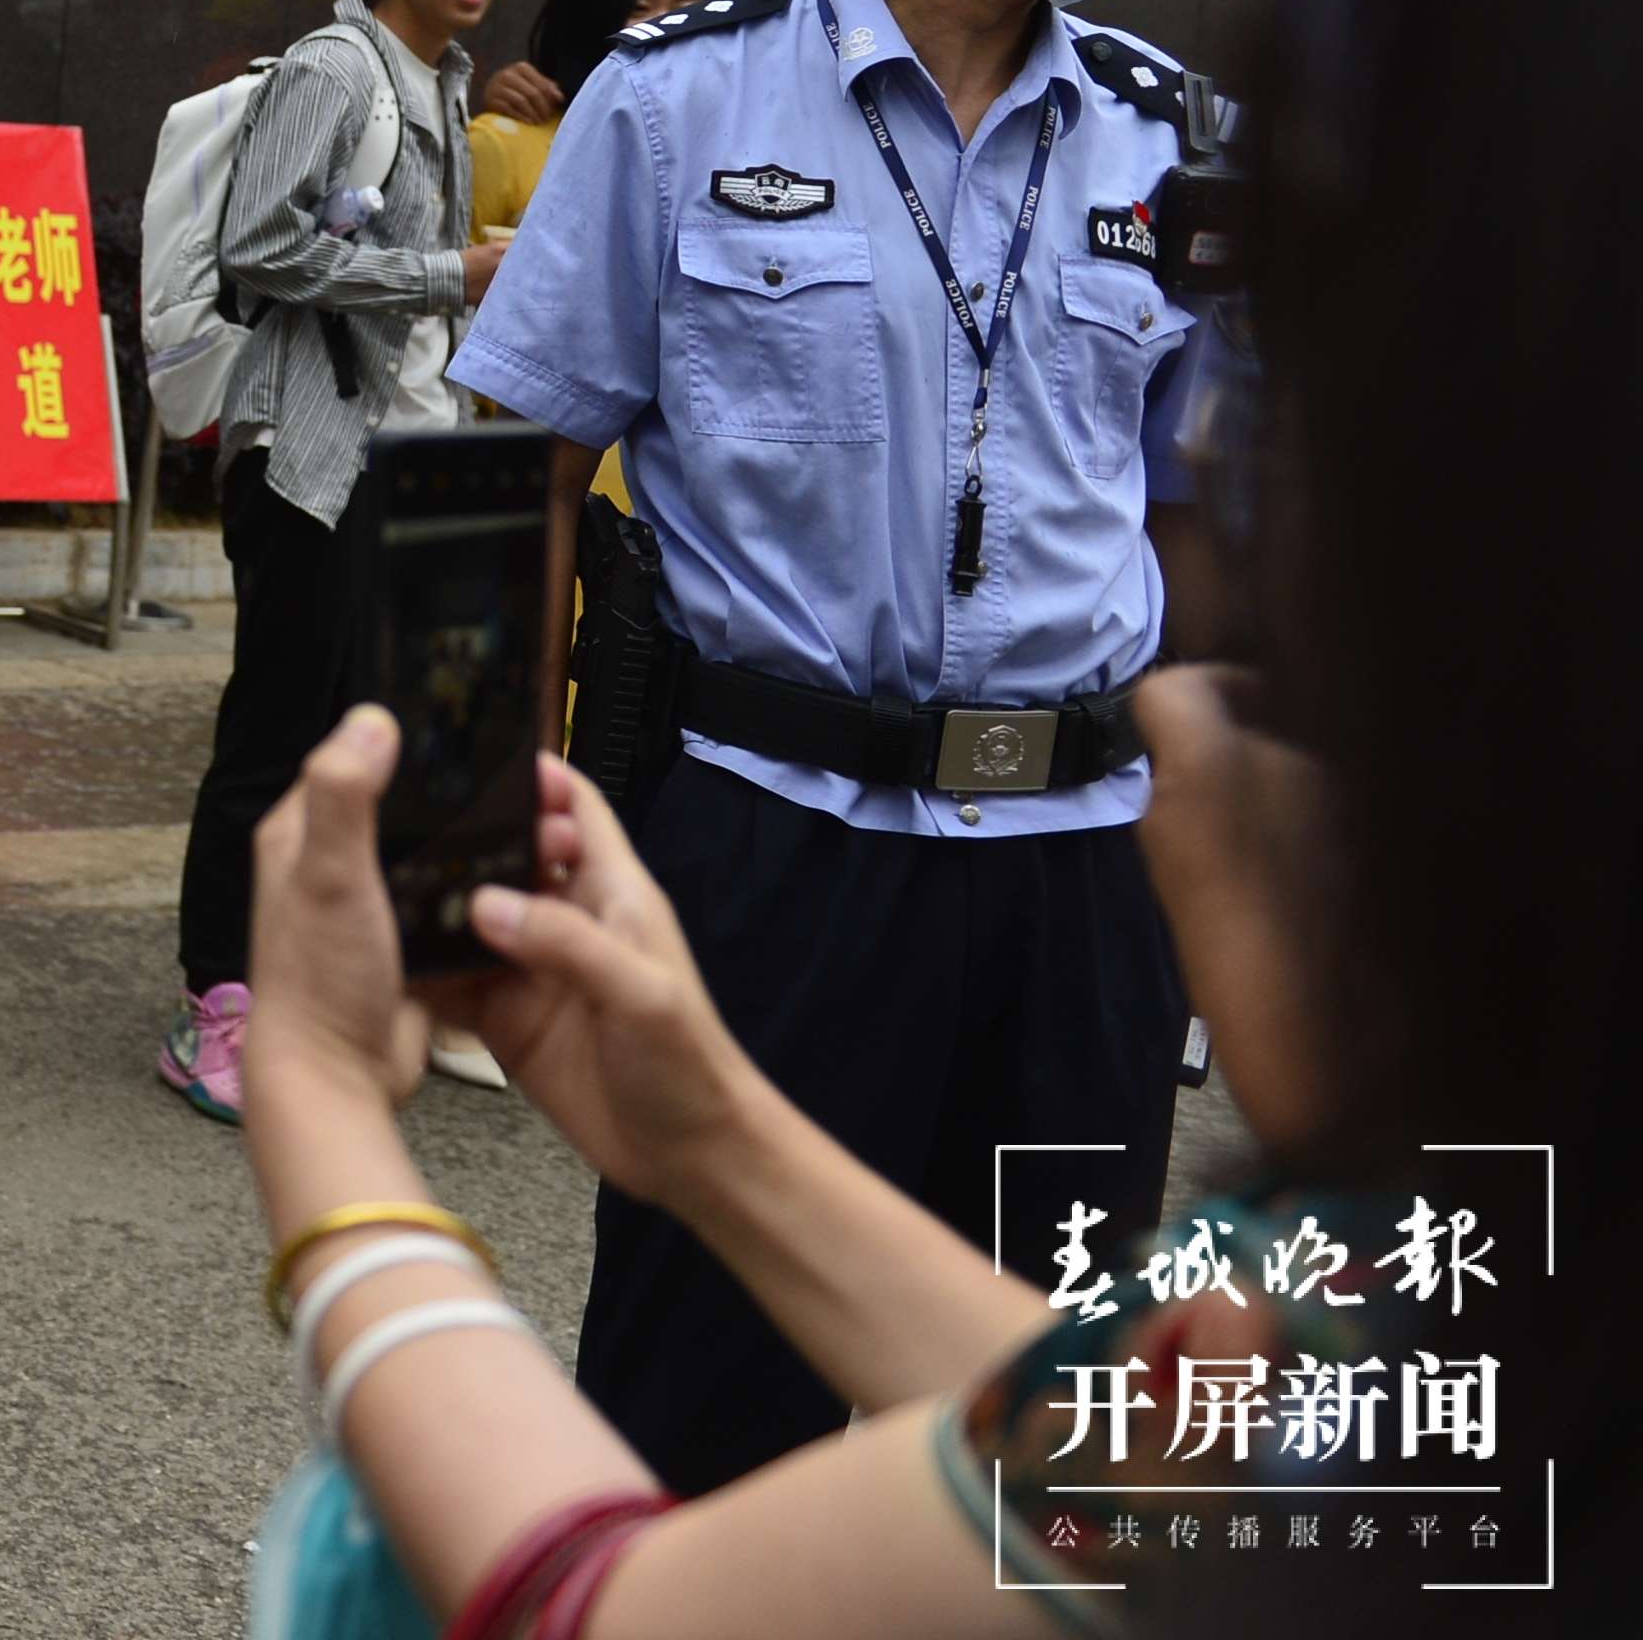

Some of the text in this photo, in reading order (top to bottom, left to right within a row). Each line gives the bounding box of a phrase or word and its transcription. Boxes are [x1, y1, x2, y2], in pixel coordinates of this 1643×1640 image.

[862, 103, 892, 150] POLICE
[1038, 106, 1058, 148] POLICE
[903, 188, 934, 238] POLICE
[1018, 186, 1039, 232] POLICE
[944, 278, 974, 329] POLICE
[995, 271, 1018, 319] POLICE
